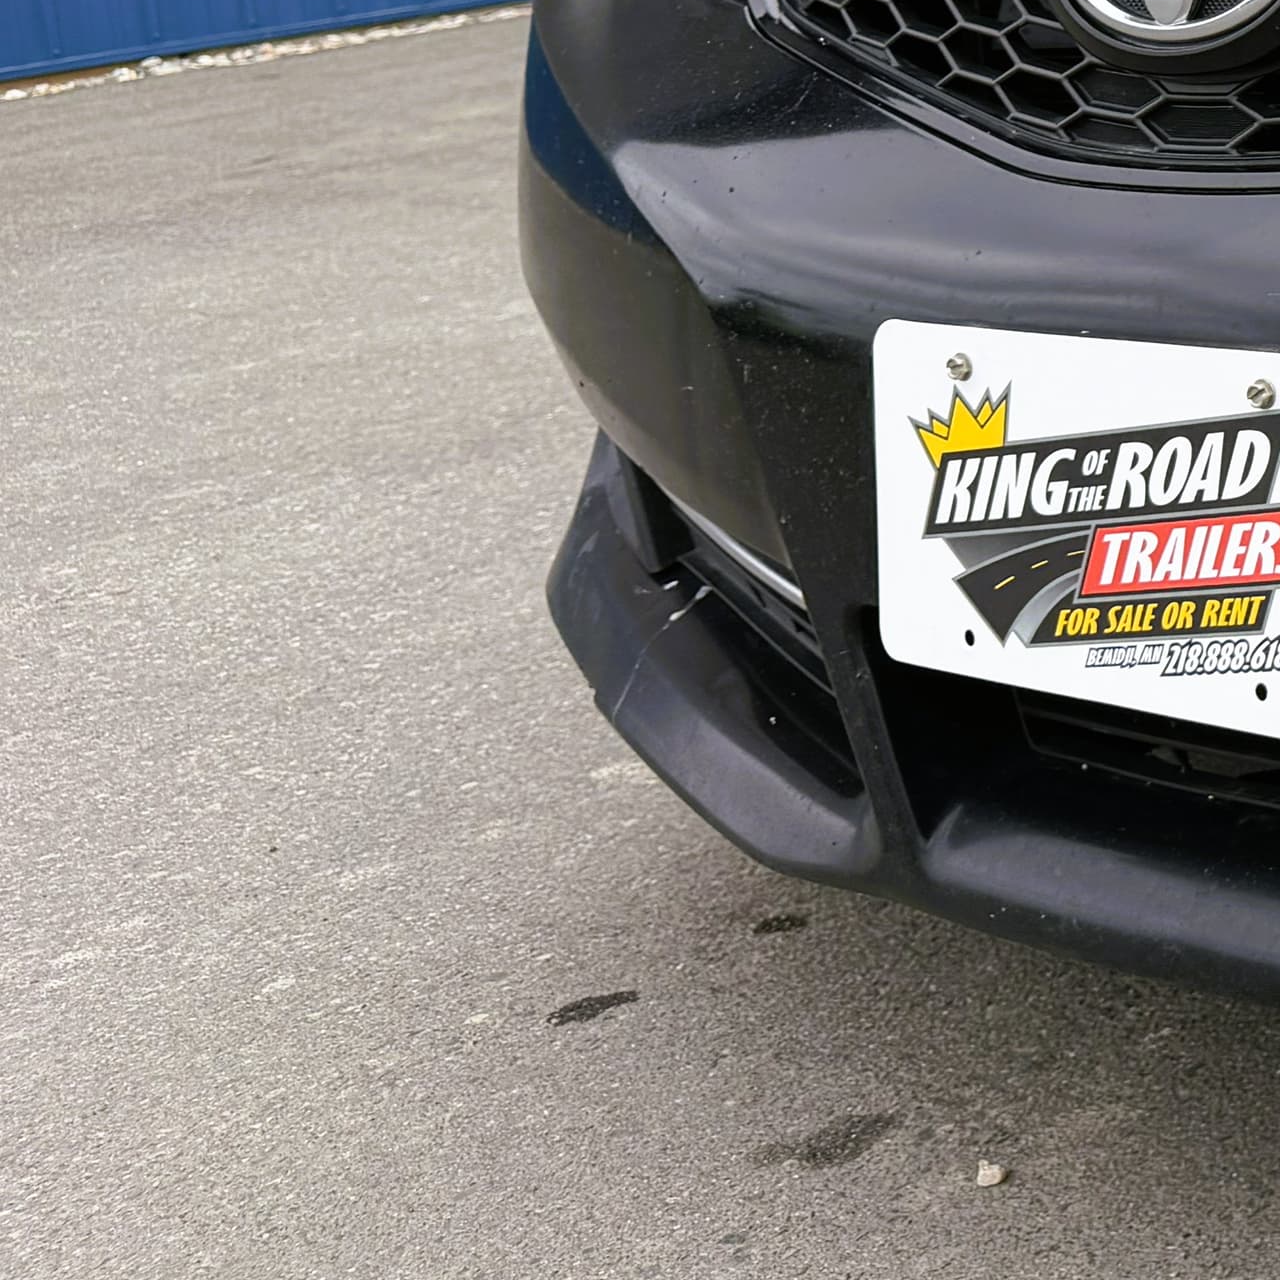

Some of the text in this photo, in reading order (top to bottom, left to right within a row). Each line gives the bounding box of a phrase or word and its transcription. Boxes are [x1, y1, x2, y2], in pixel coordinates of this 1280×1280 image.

[935, 429, 1272, 524] KING OF THE ROAD
[1055, 597, 1265, 636] FOR SALE OR RENT
[1138, 644, 1164, 665] MN
